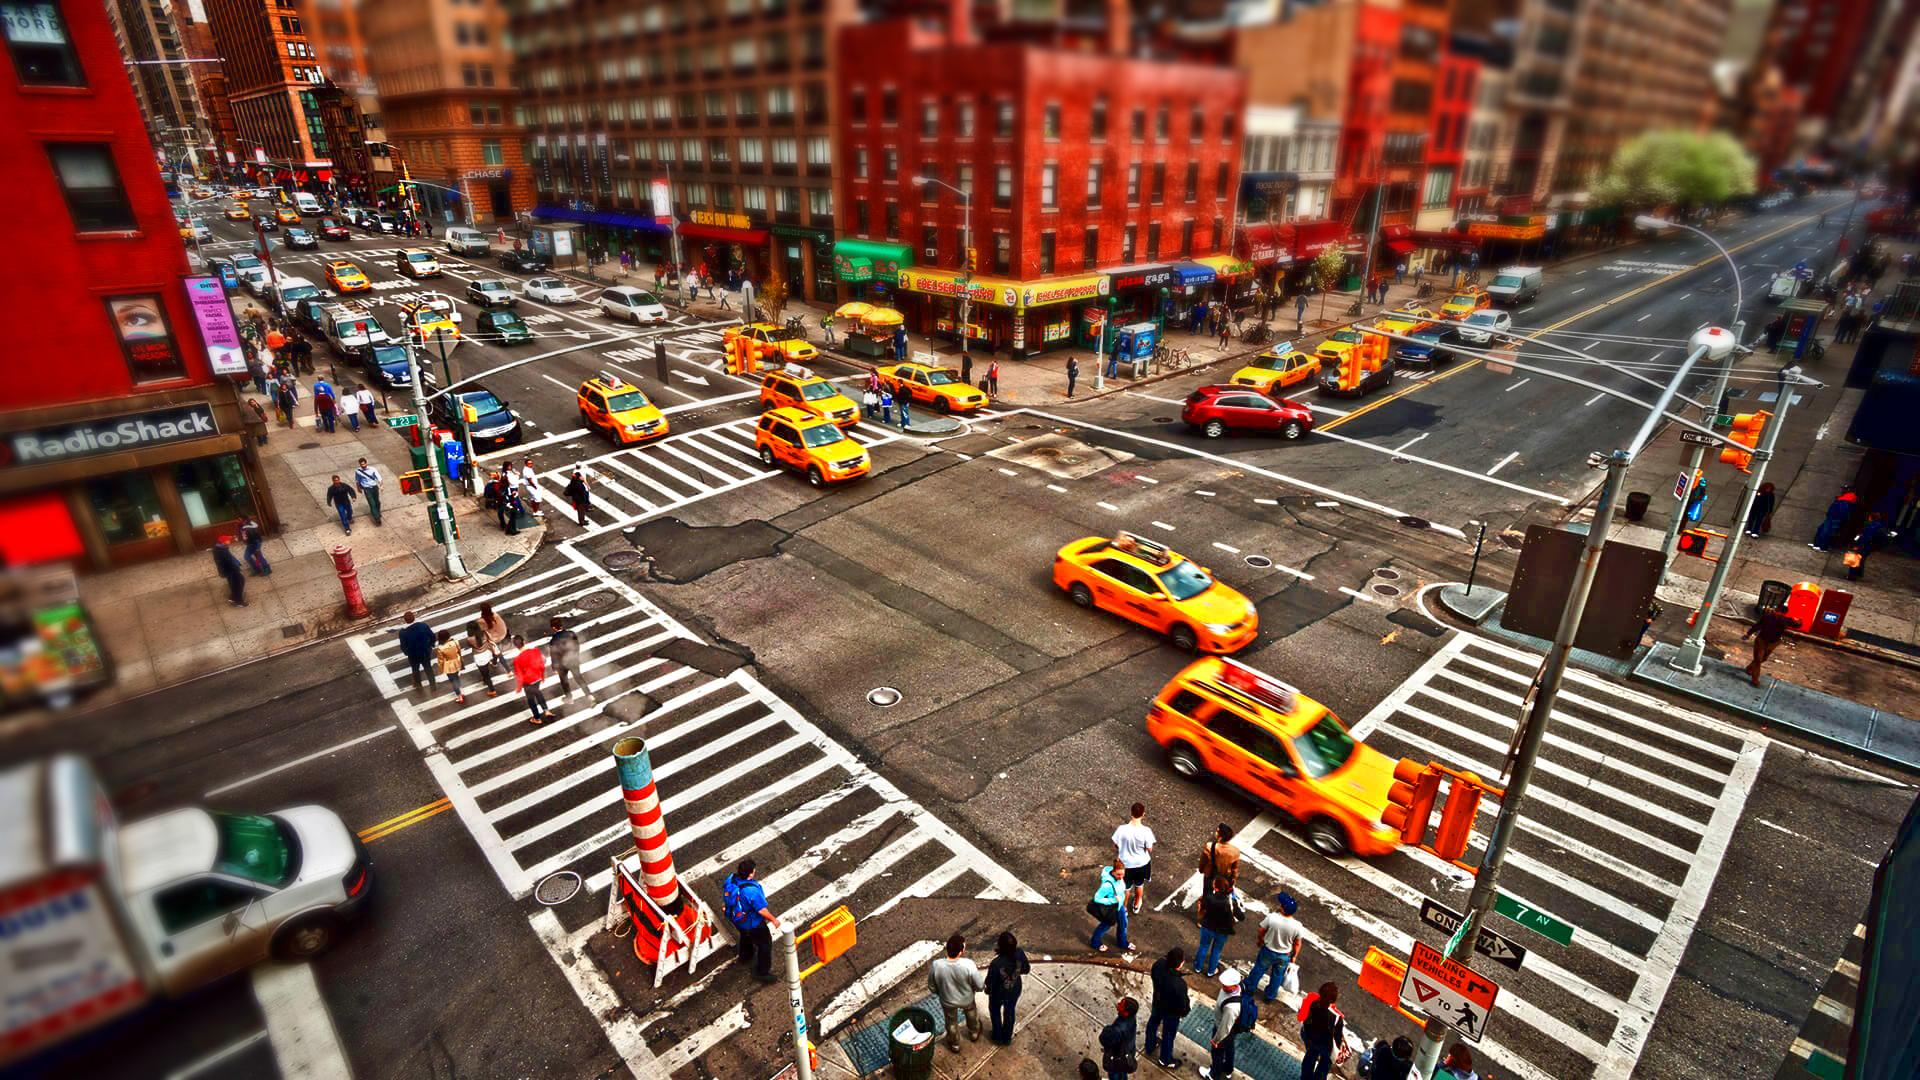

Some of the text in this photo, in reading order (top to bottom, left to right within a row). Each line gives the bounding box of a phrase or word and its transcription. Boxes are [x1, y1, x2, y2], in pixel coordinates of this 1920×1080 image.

[3, 16, 59, 30] NORD
[467, 170, 502, 179] CHASE
[697, 211, 714, 225] BEACH
[727, 214, 750, 230] TANNING
[916, 278, 955, 294] CHELSEA
[956, 284, 994, 301] PAAYA
[1037, 284, 1097, 302] CHELSEA PAPAYA
[133, 350, 172, 360] THREADING
[400, 417, 410, 425] 23
[1725, 415, 1732, 425] 7
[14, 412, 214, 461] RadioShack
[1683, 432, 1713, 444] ONE WAY
[1434, 912, 1462, 932] ONE
[1516, 904, 1551, 926] 7 AV
[1418, 947, 1466, 979] TURNING
[1417, 958, 1462, 989] VEHICLES
[1437, 998, 1451, 1011] TO
